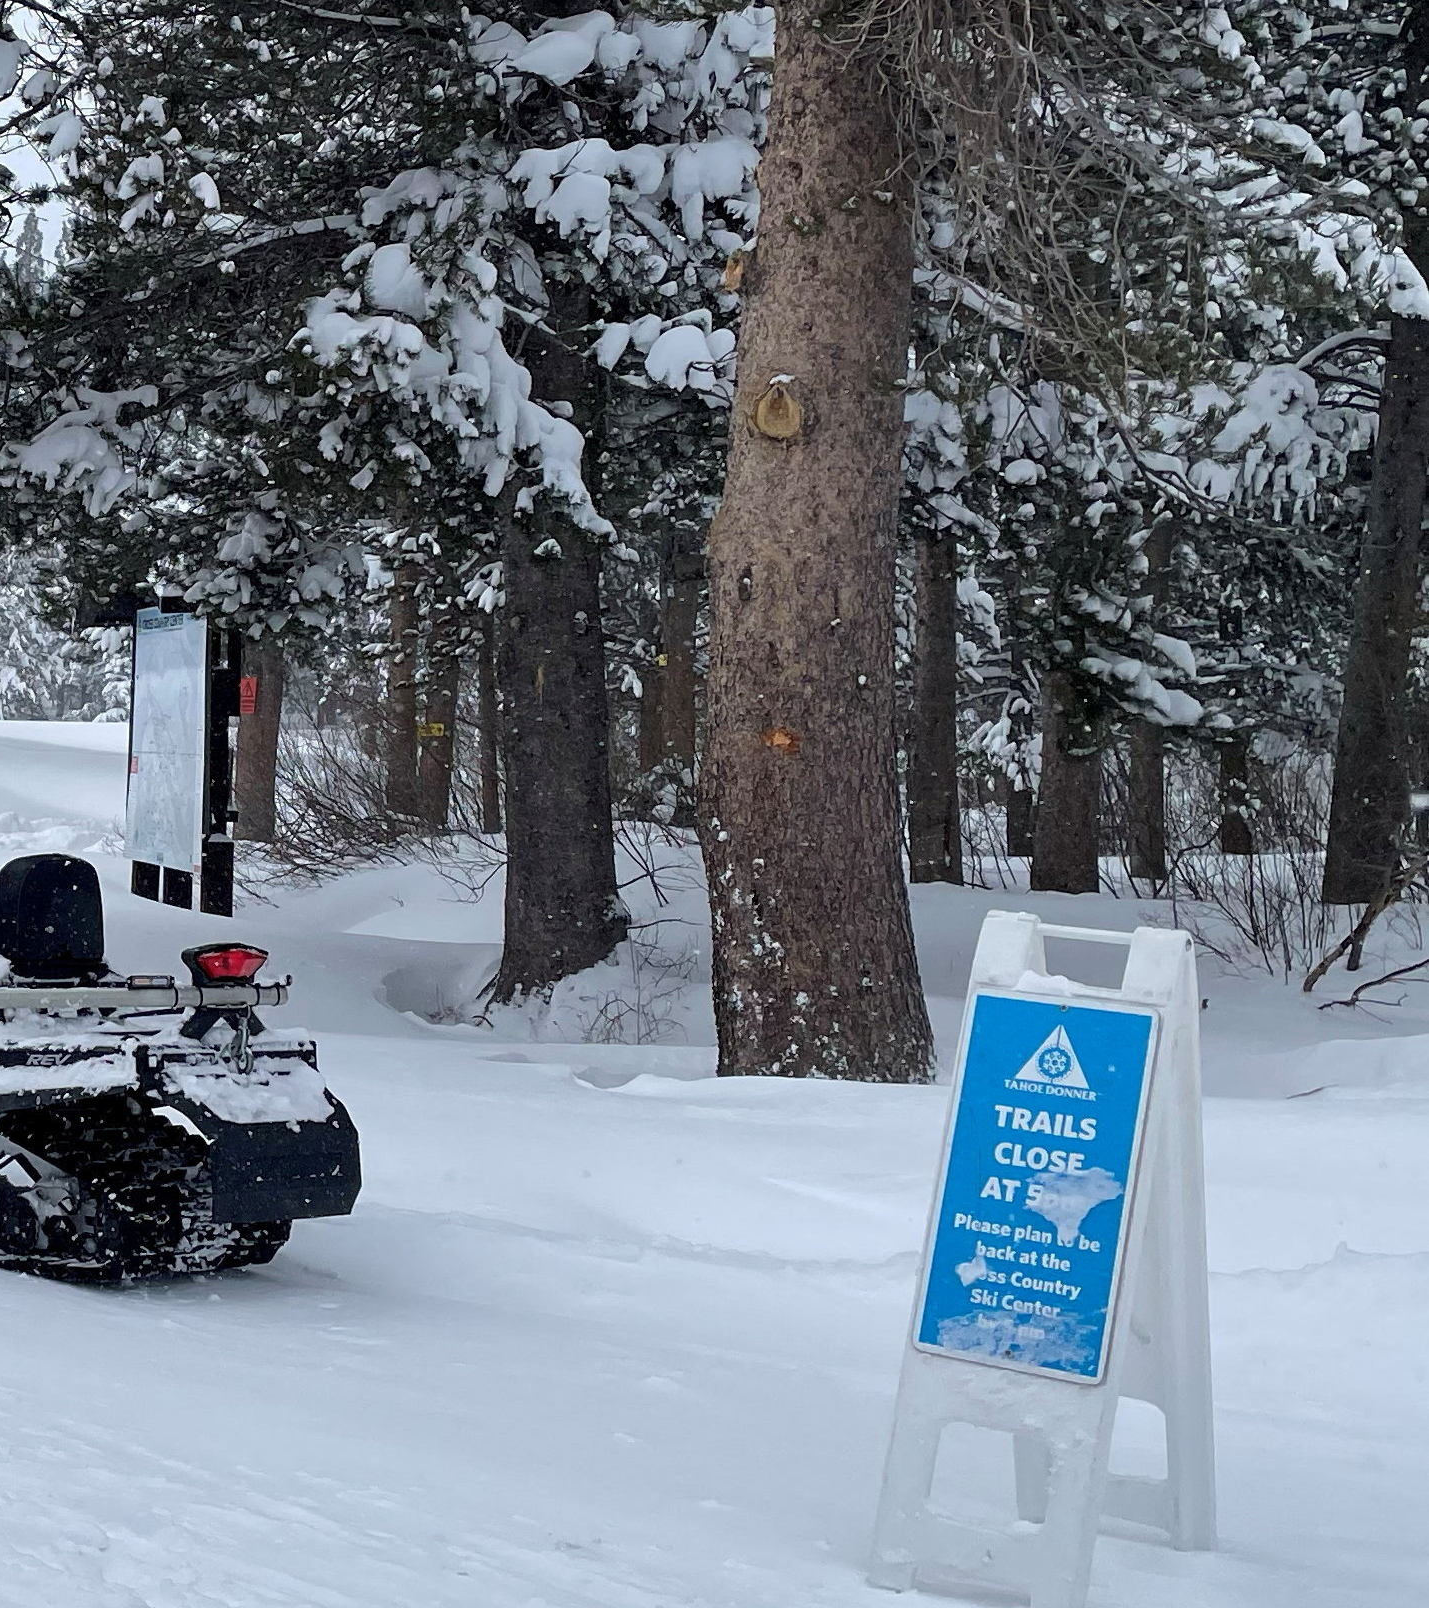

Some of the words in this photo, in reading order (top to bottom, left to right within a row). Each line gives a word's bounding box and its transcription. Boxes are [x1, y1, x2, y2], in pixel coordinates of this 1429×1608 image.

[25, 1053, 72, 1066] REV
[1003, 1079, 1044, 1094] TAHOE
[1045, 1085, 1097, 1101] DONNER
[995, 1105, 1097, 1141] TRAILS
[994, 1142, 1085, 1174] CLOSE
[980, 1176, 1021, 1203] AT
[954, 1212, 1012, 1237] Please
[1013, 1225, 1052, 1244] plan
[1078, 1234, 1101, 1252] be
[976, 1240, 1017, 1262] back
[1019, 1251, 1038, 1266] at
[1041, 1253, 1071, 1272] the
[1011, 1271, 1082, 1301] Country
[970, 1288, 999, 1307] Ski
[1001, 1295, 1061, 1317] Center
